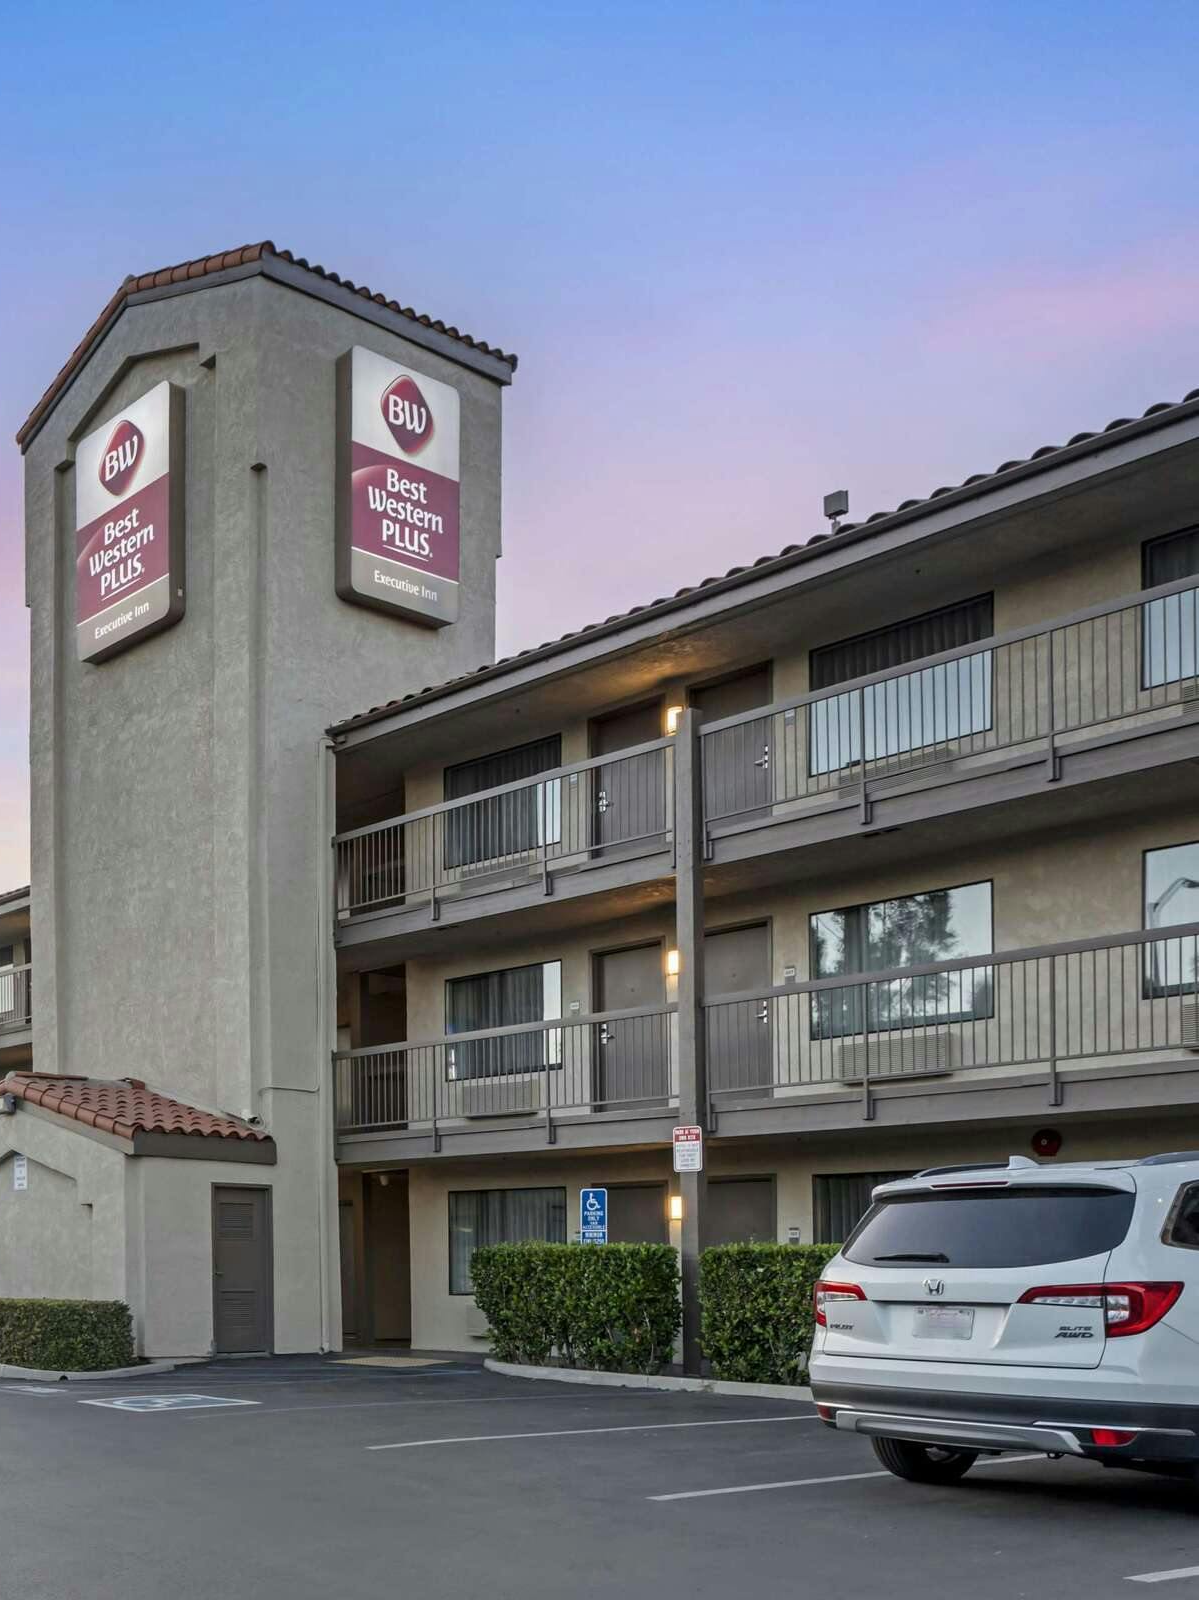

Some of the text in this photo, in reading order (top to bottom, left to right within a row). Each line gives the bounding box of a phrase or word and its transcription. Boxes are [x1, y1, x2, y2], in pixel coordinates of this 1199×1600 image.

[389, 394, 427, 434] BW
[105, 435, 138, 482] BW
[386, 468, 427, 504] Best
[104, 507, 140, 546] Best
[368, 485, 444, 534] Western
[89, 524, 155, 577] Western
[374, 569, 438, 601] Executive Inn
[94, 602, 150, 640] Executive Inn
